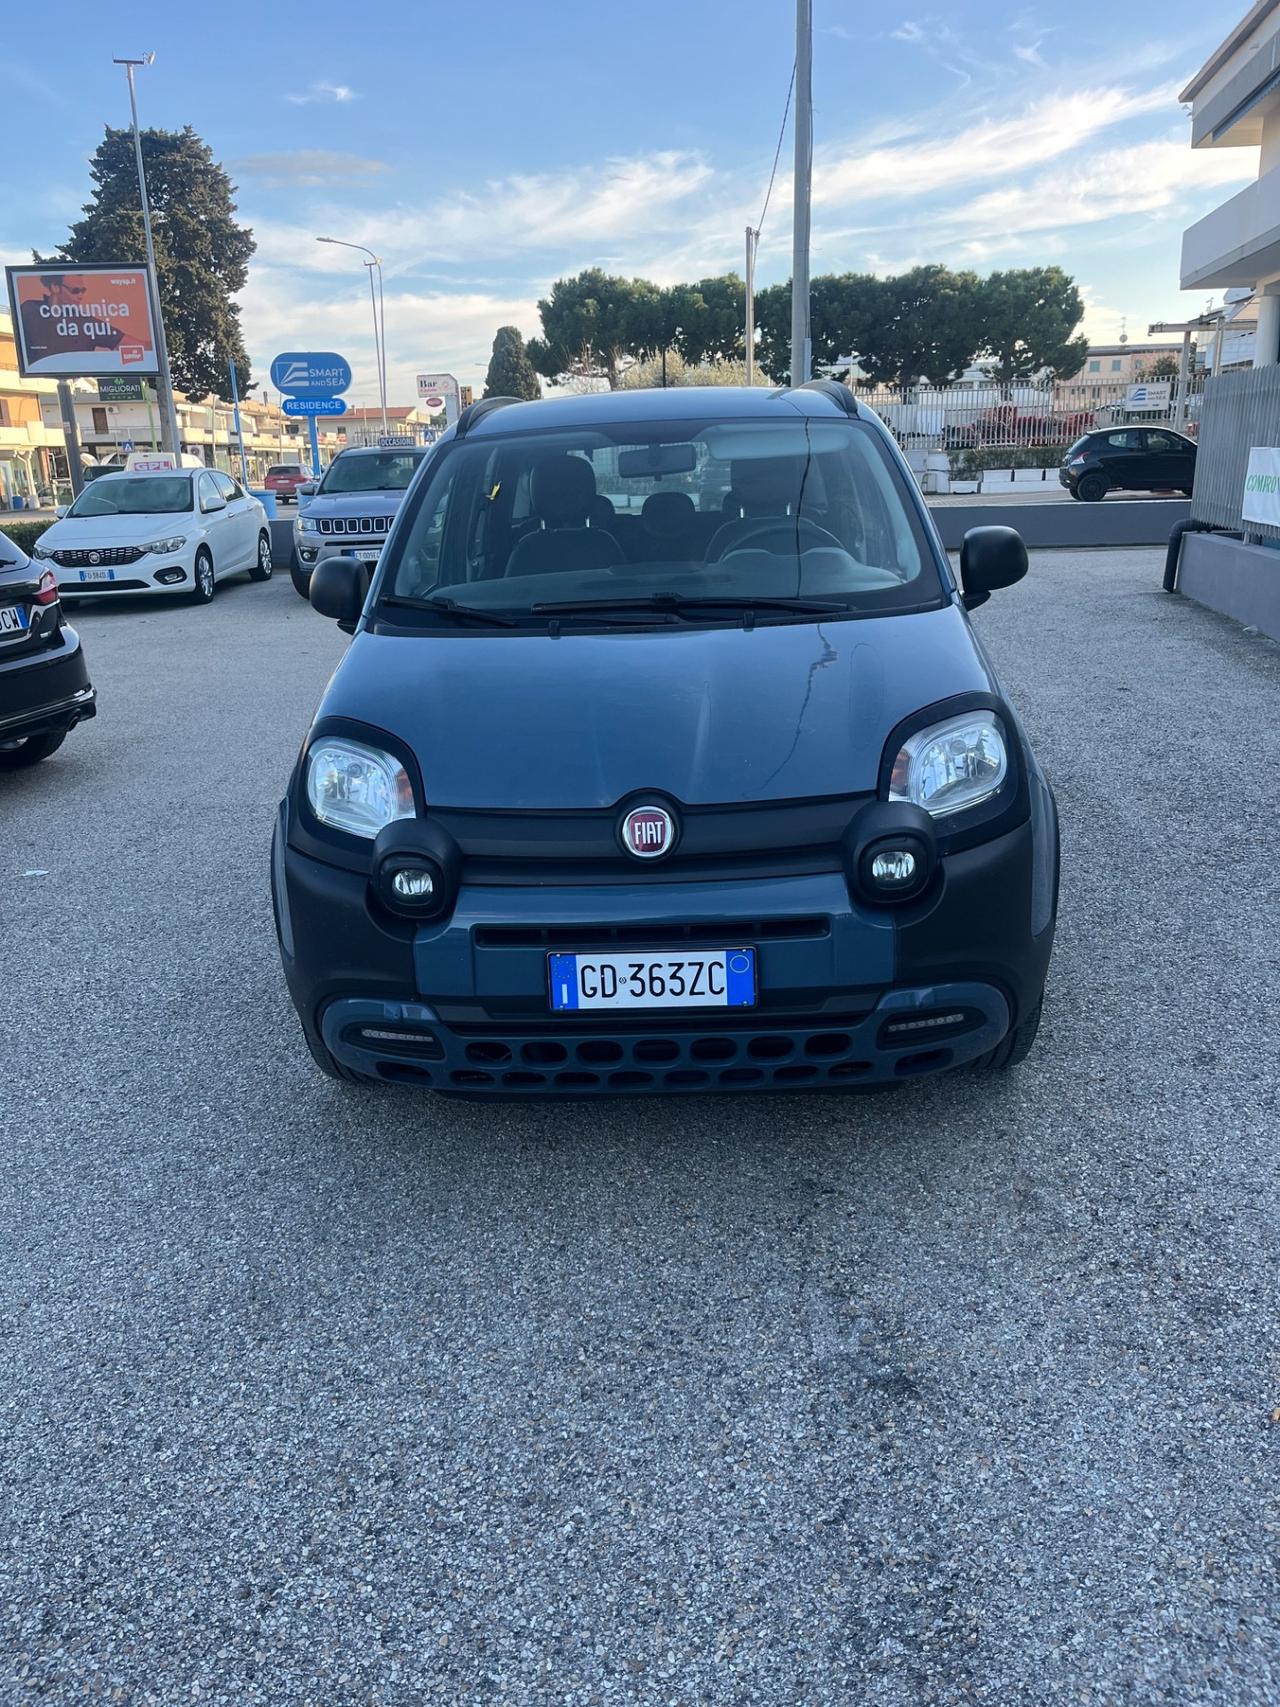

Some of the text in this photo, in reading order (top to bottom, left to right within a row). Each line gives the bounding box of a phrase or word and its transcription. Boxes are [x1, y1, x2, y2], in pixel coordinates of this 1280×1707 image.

[39, 299, 130, 318] comunica
[56, 318, 117, 340] da qui.
[309, 368, 345, 377] SMART
[99, 384, 141, 393] MIGLIORATI
[420, 380, 437, 388] Bar
[286, 401, 342, 410] RESIDENCE
[381, 436, 415, 446] OCCASIONE
[134, 462, 169, 471] GPL
[0, 608, 20, 631] CW
[634, 821, 664, 845] FIAT
